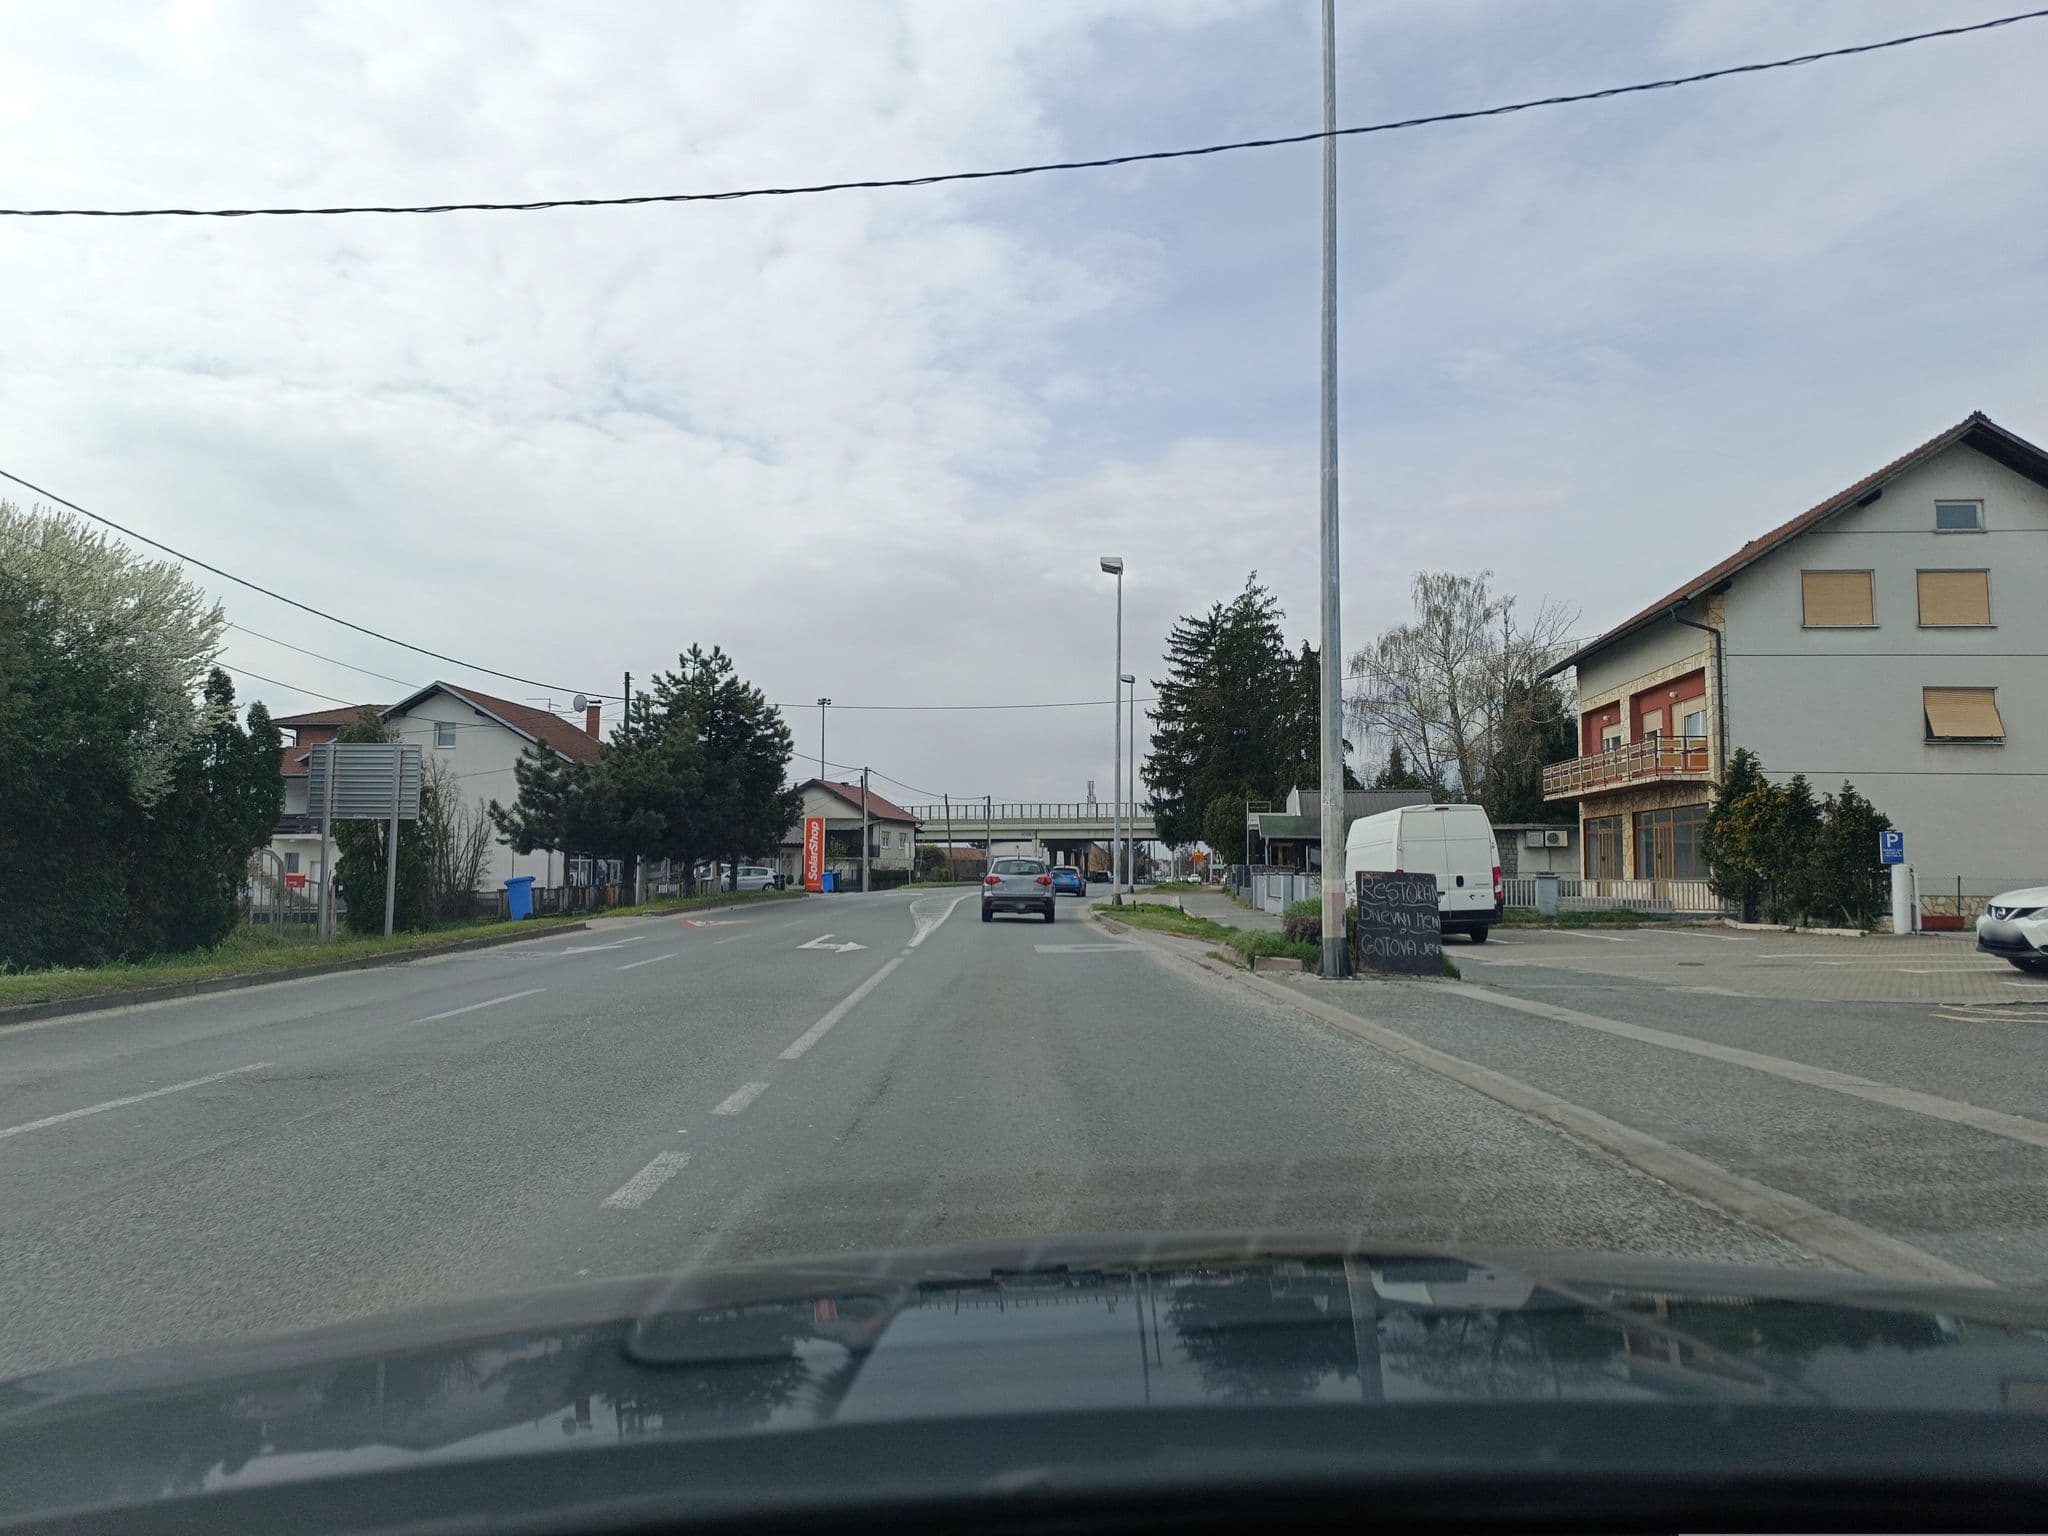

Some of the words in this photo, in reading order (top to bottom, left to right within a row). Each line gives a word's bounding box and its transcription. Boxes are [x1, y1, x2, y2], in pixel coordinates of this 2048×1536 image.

[808, 821, 820, 880] SolarShop
[1886, 833, 1899, 848] P
[1361, 934, 1417, 957] GOTOVA
